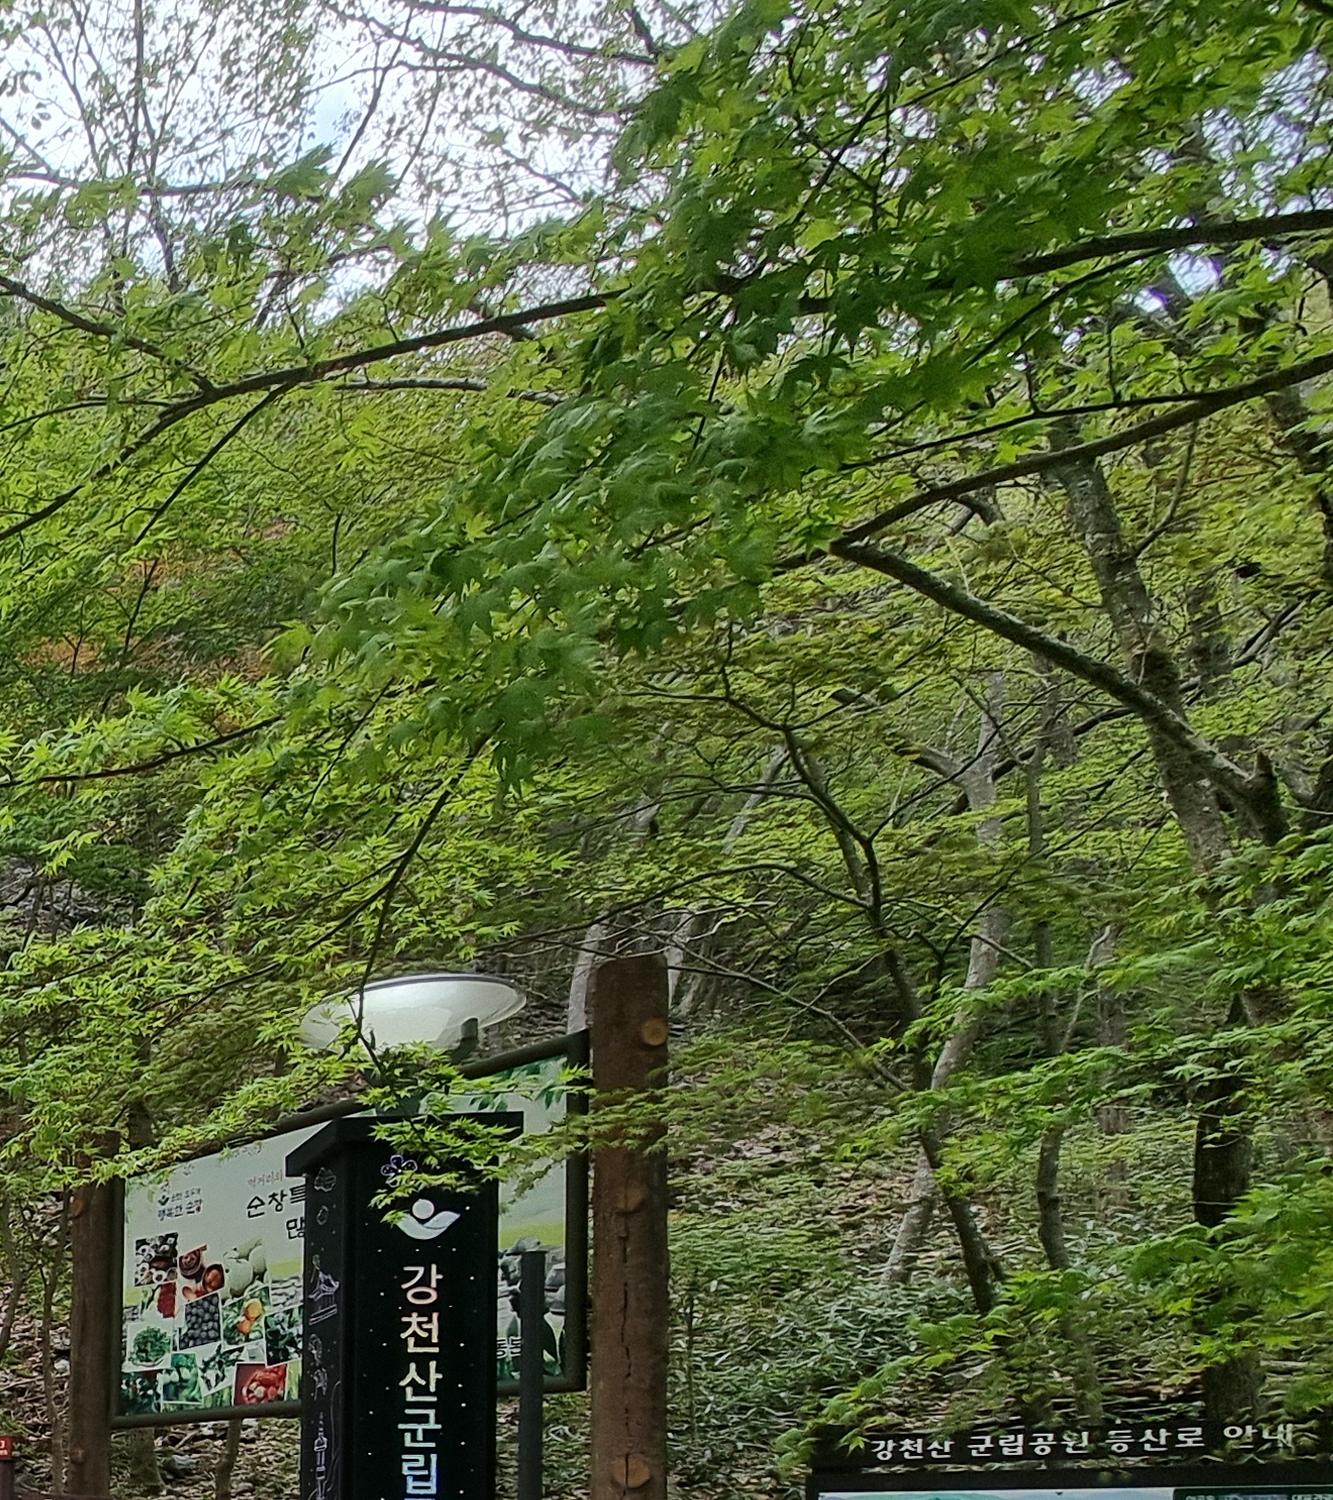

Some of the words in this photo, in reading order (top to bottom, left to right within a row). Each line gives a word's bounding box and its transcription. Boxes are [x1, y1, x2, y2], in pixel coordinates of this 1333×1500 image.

[871, 1438, 953, 1463] 강천산
[968, 1430, 1089, 1459] 군립공원
[1104, 1426, 1205, 1453] 등산로
